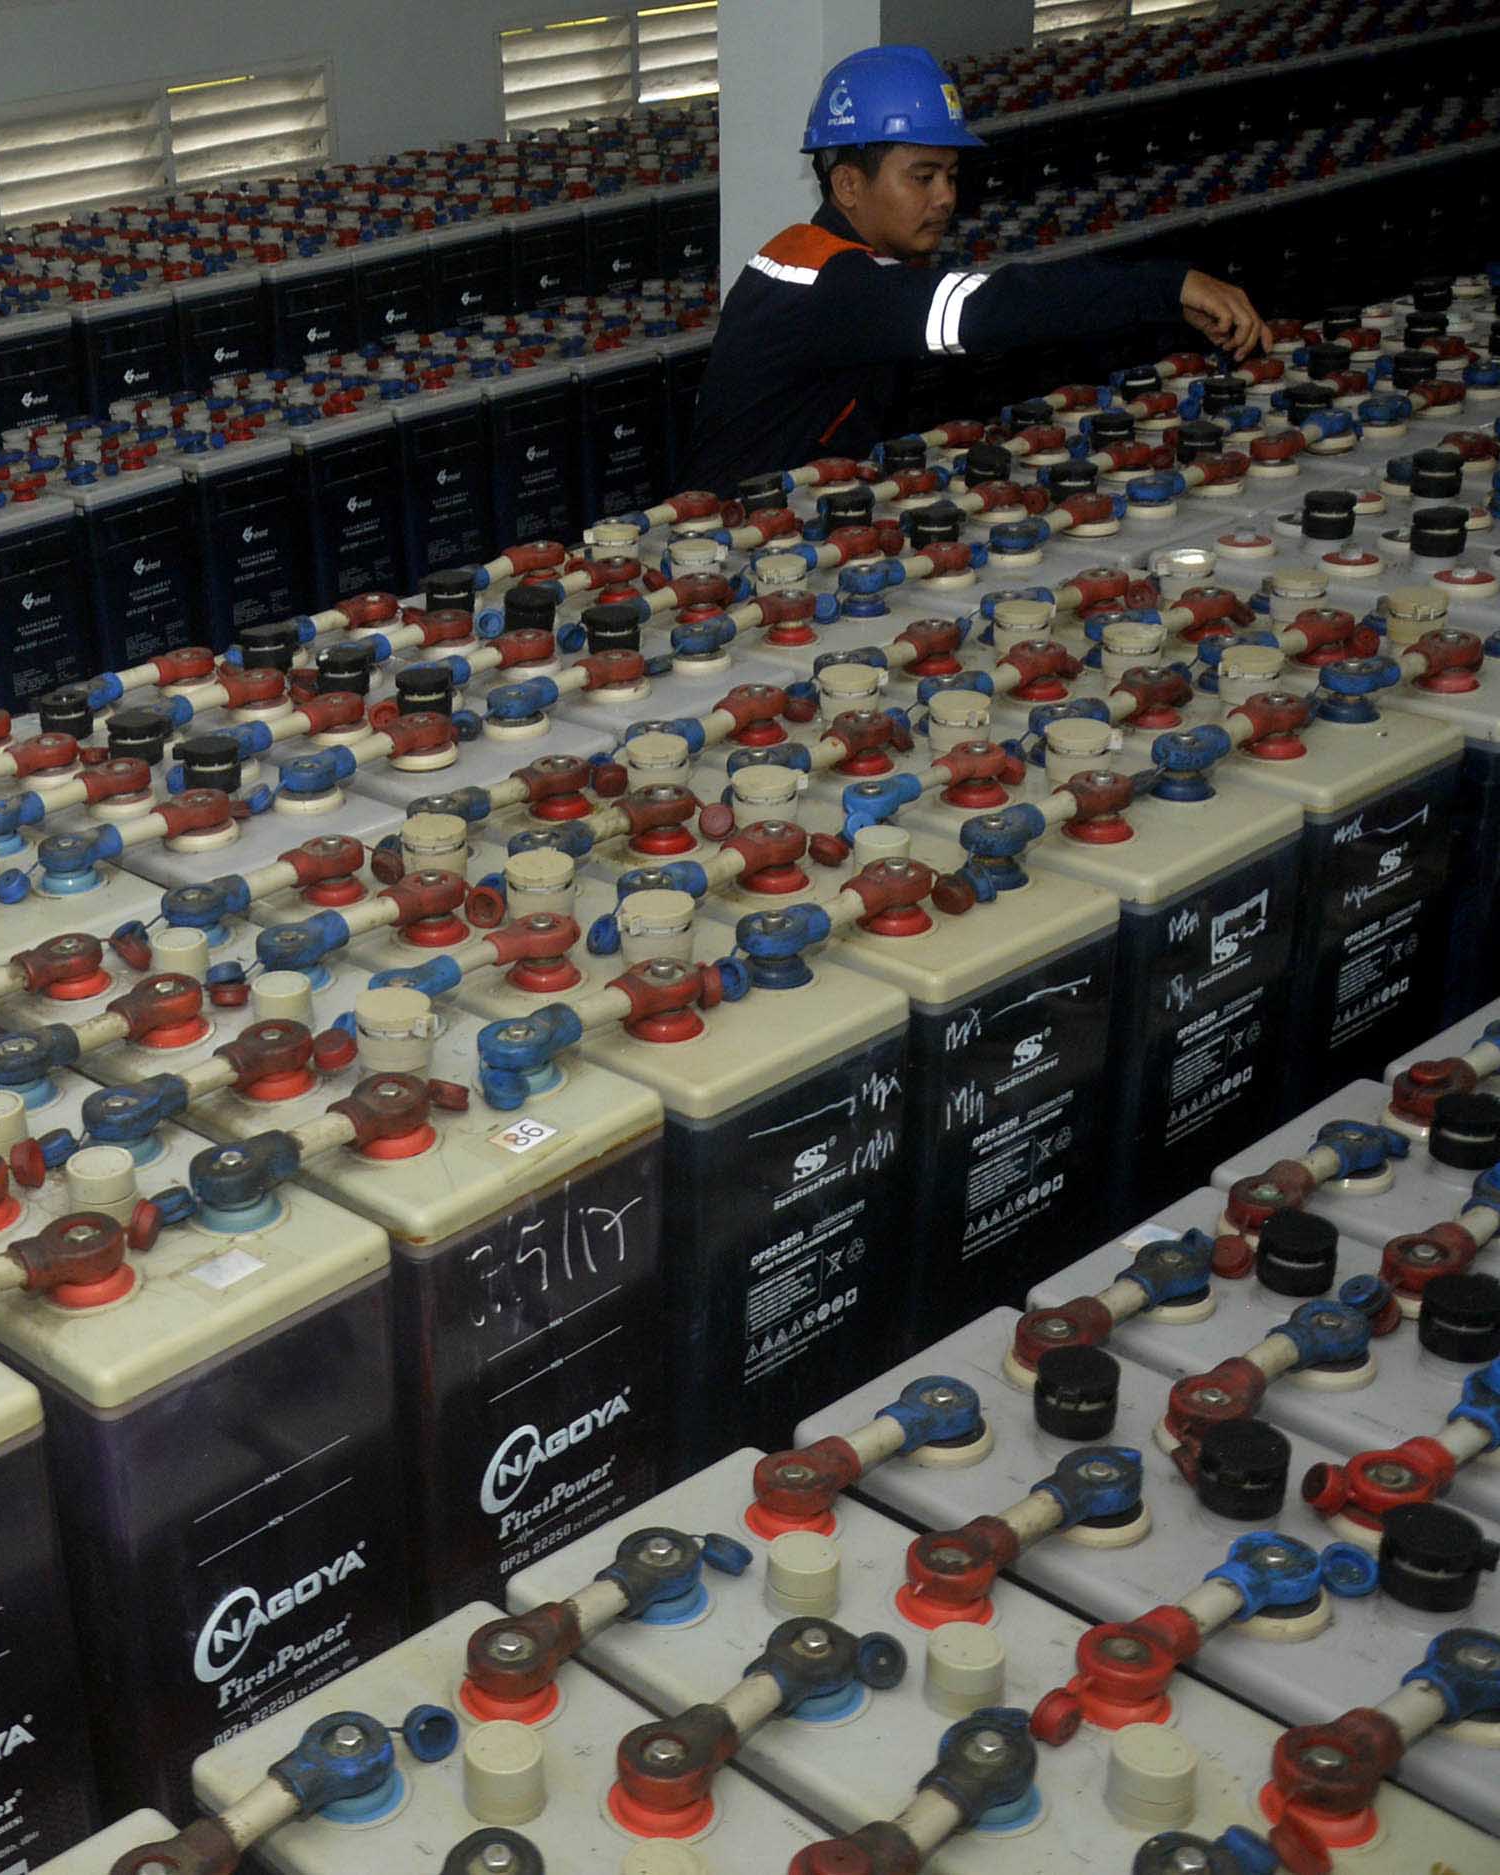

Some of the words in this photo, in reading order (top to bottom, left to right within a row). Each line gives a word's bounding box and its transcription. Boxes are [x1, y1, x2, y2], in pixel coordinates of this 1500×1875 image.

[773, 1167, 847, 1211] SunStonePower
[494, 1394, 631, 1489] NAGOYA
[498, 1461, 612, 1540] FirstPower
[209, 1549, 367, 1656] NAGOYA
[217, 1619, 348, 1709] FirstPower
